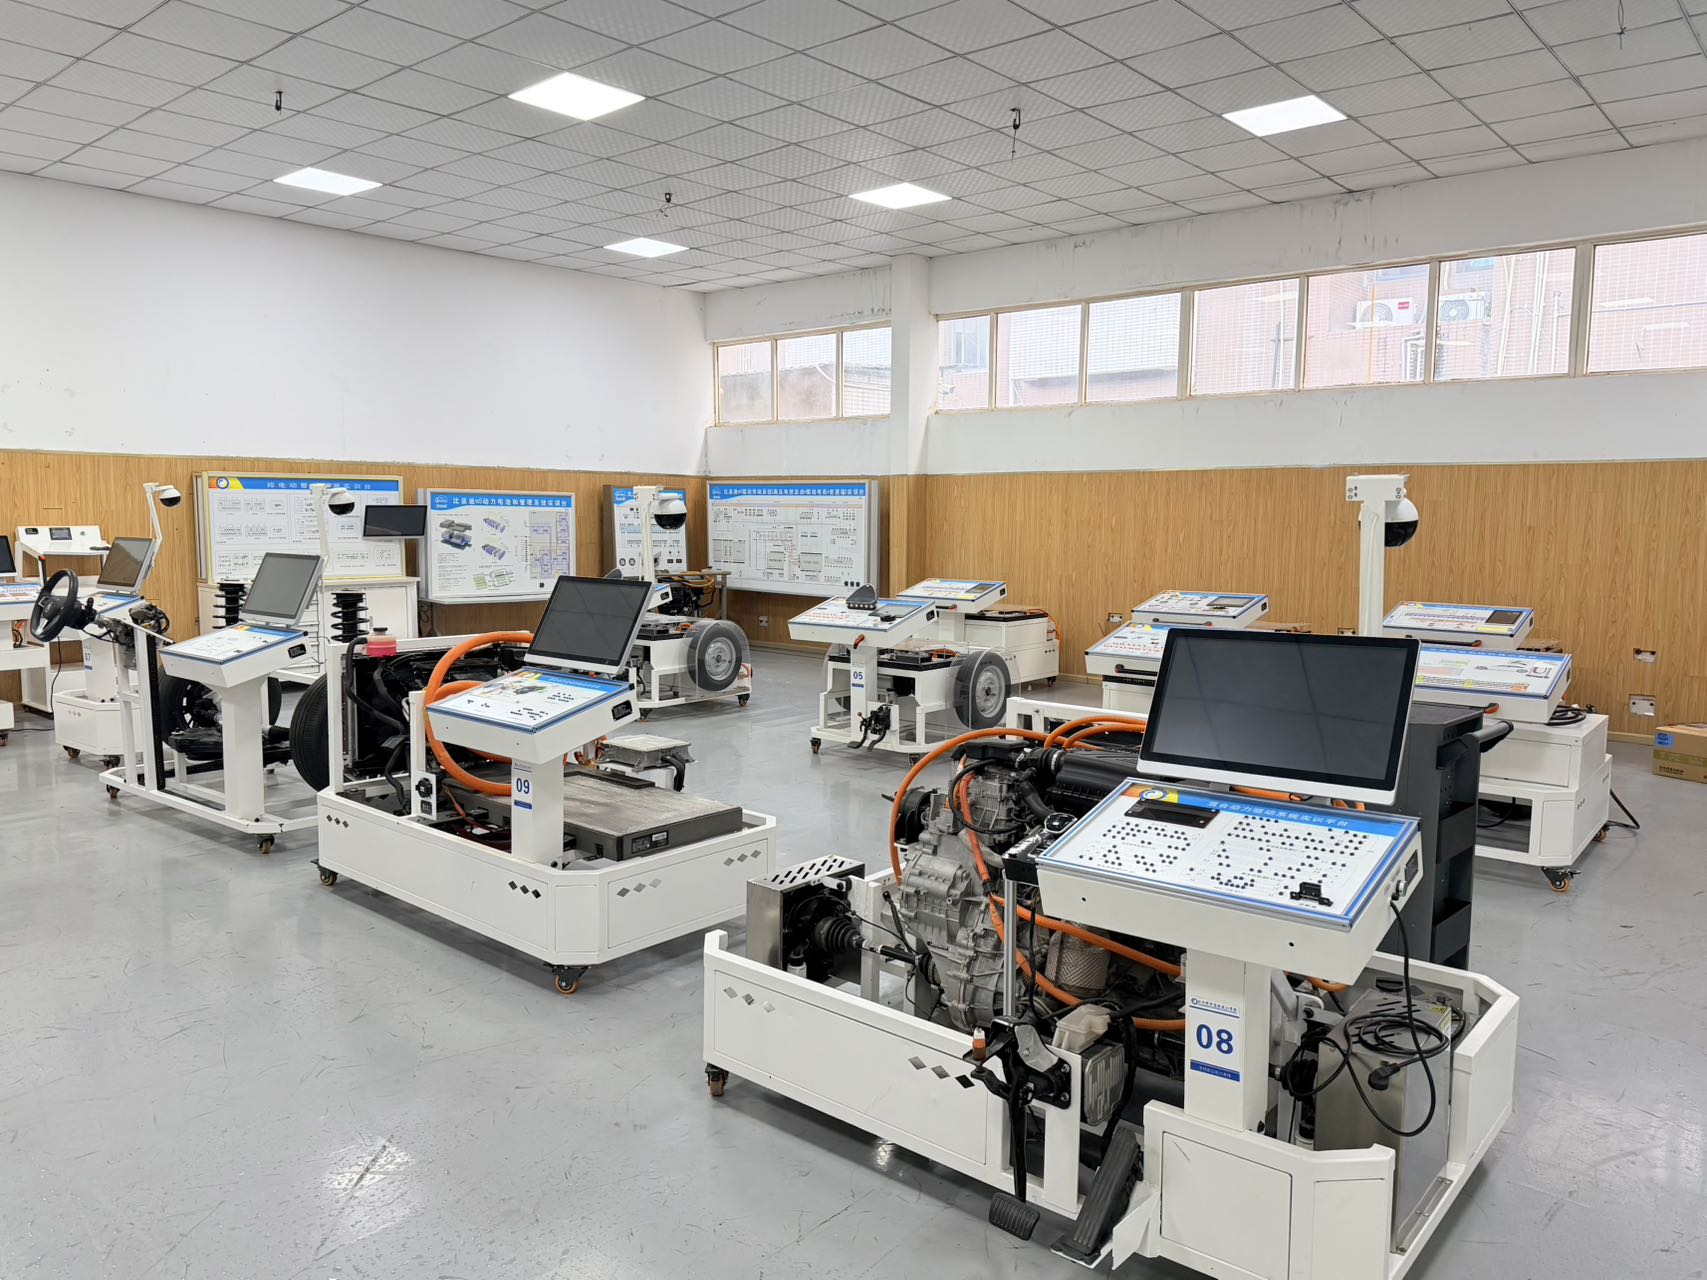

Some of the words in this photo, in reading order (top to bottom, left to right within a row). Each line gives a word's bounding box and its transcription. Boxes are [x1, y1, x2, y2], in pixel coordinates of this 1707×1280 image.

[853, 671, 863, 680] 05
[516, 777, 530, 794] 09
[1196, 1023, 1234, 1055] 08
